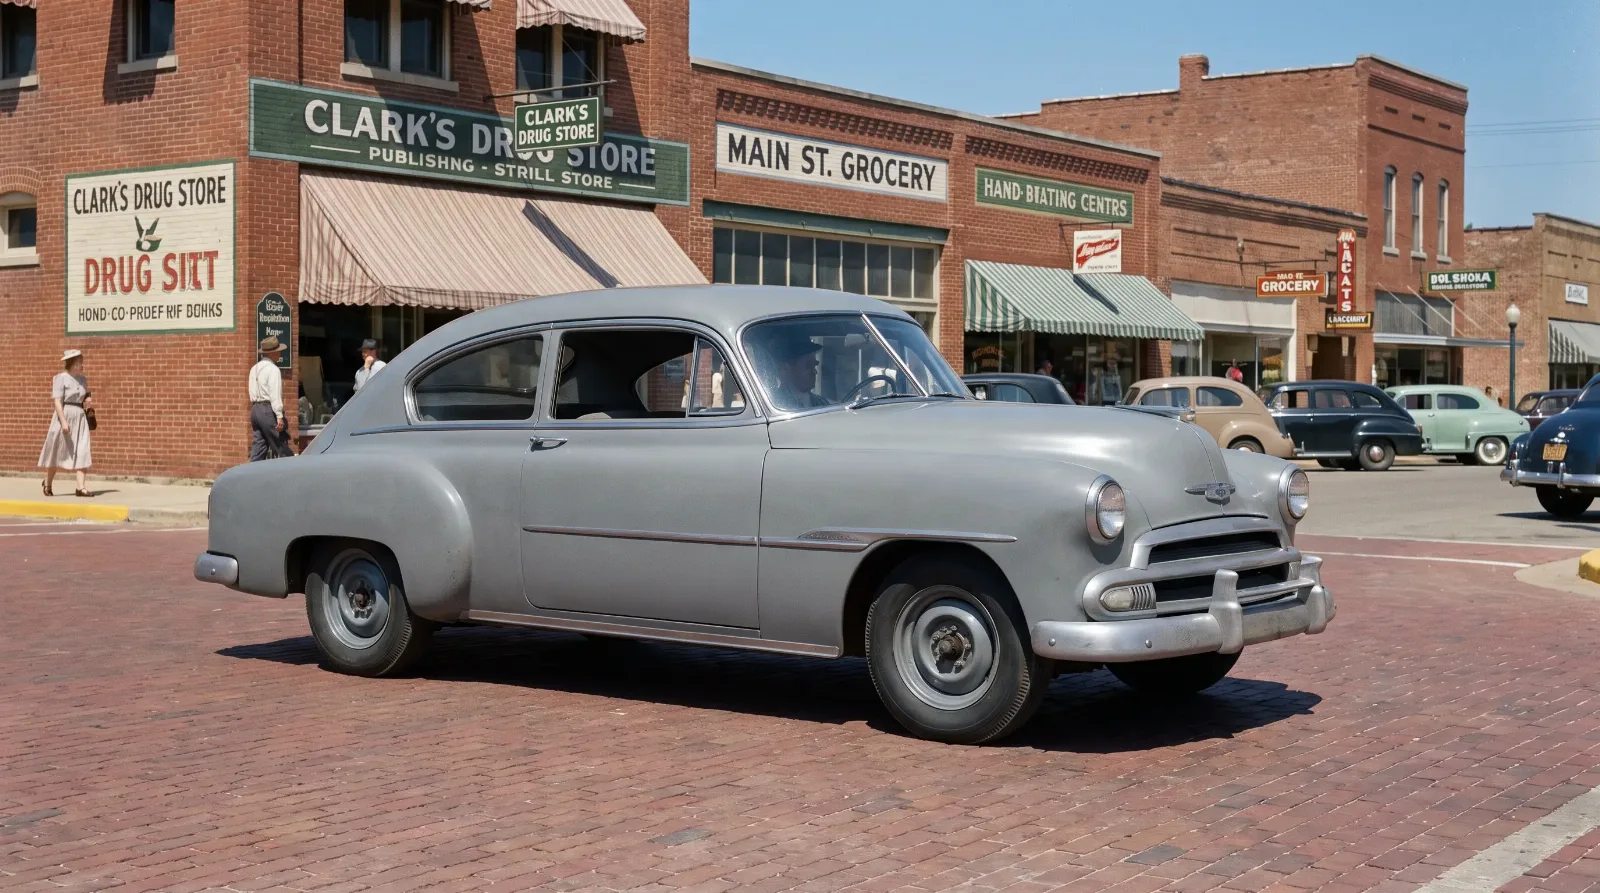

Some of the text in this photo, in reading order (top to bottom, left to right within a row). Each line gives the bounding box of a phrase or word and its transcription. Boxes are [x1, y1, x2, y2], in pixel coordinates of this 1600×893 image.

[518, 123, 595, 146] DRUG STORE
[524, 104, 589, 126] CLARK'S
[304, 99, 456, 151] CLARK'S
[566, 142, 656, 176] STORE
[369, 146, 475, 173] PUBLISHNG
[494, 163, 555, 182] STRILL
[561, 171, 613, 189] STORE
[728, 132, 937, 192] MAIN ST. GROCERY
[73, 175, 226, 215] CLARK'S DRUG STORE
[1080, 193, 1127, 217] CENTRS
[84, 253, 152, 296] DRUG
[1261, 280, 1319, 292] GROCERY
